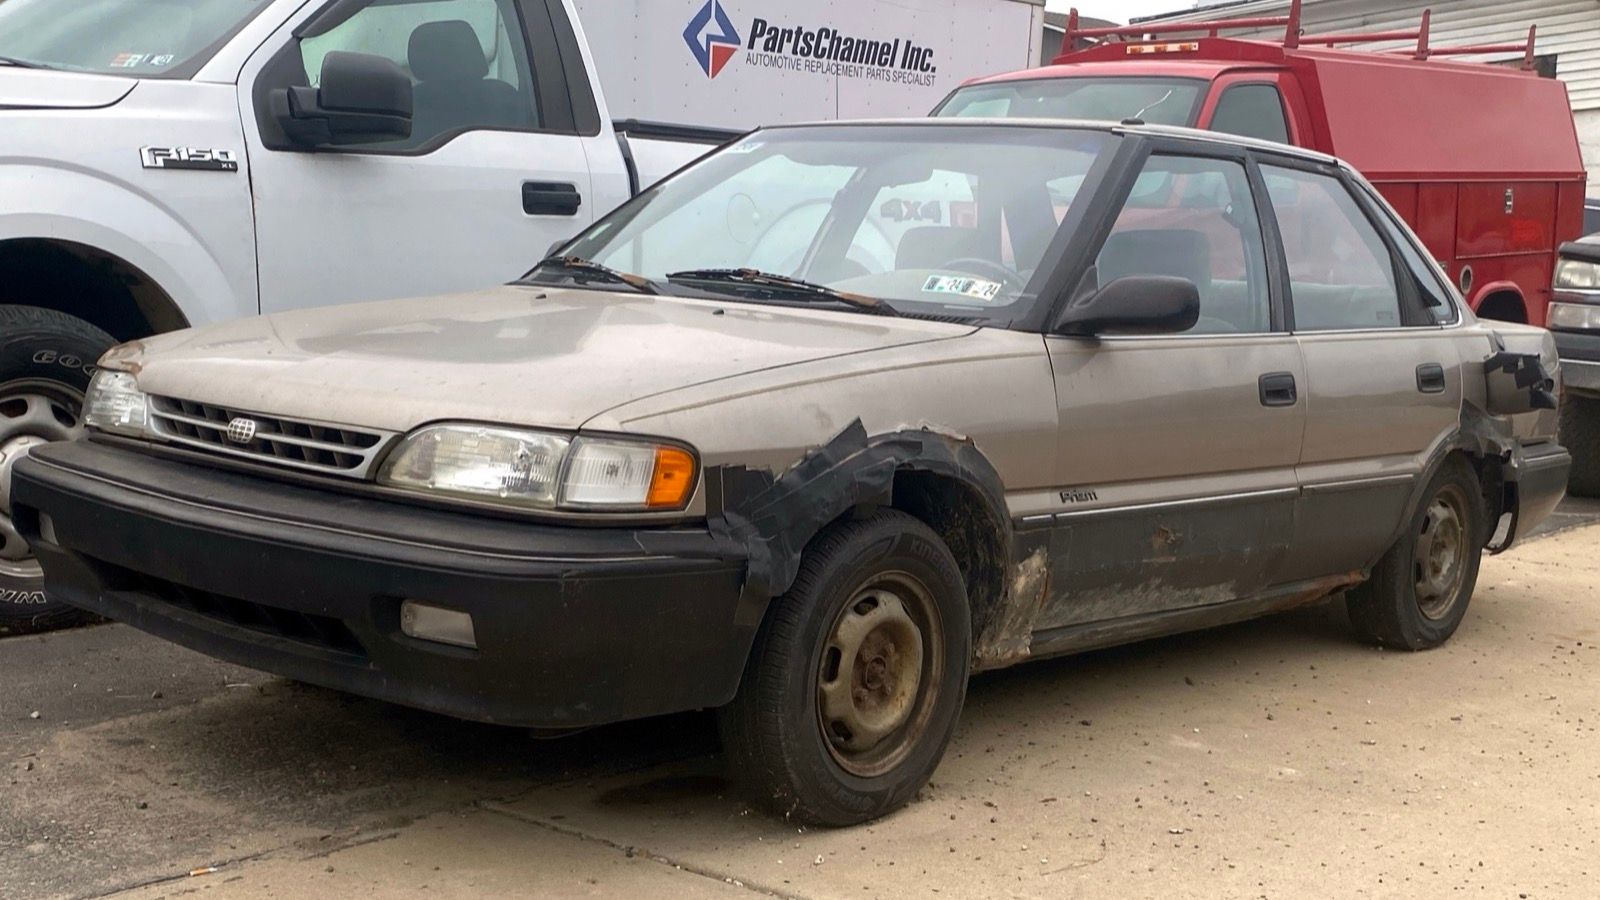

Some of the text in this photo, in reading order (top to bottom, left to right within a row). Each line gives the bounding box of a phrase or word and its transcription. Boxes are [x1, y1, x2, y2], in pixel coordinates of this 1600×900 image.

[747, 17, 937, 73] PartsChannel Inc.
[745, 52, 936, 87] AUTOMOTIVE REPLACEMENT PARTS SPECIALIST
